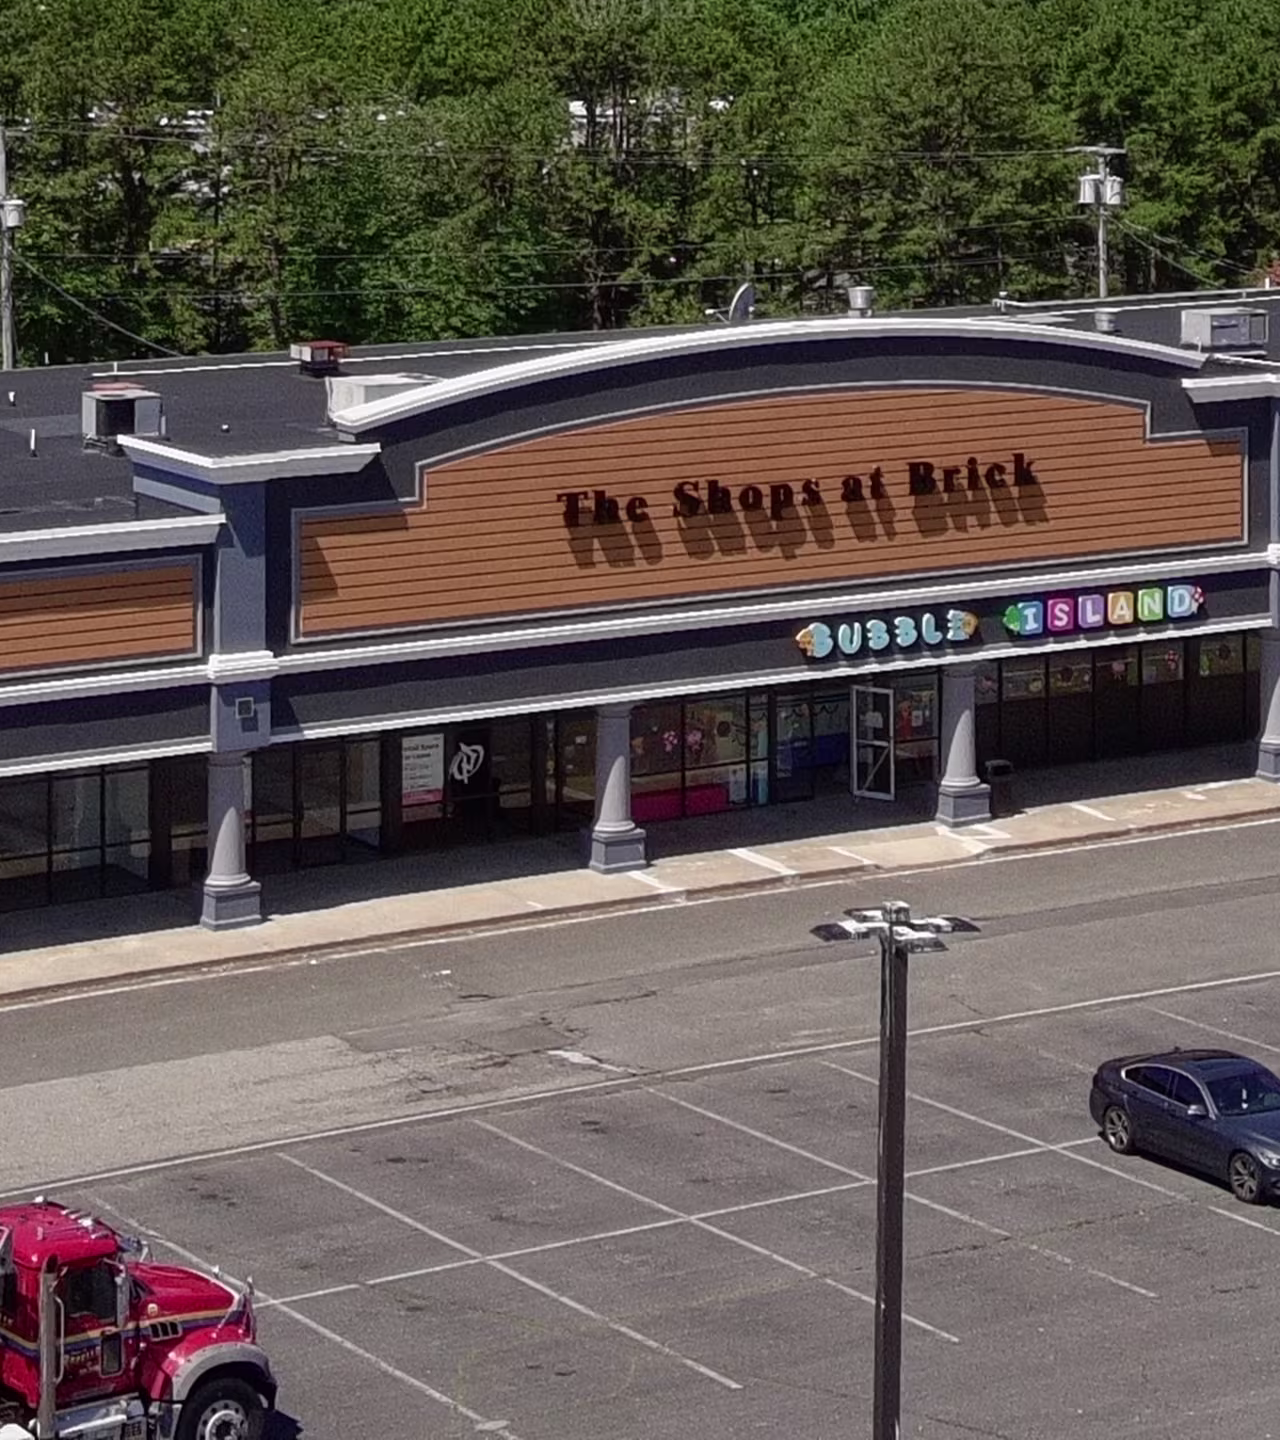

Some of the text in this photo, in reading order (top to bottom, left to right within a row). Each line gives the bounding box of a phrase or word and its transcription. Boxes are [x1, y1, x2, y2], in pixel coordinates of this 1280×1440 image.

[557, 453, 1036, 528] The Shops at Brick
[805, 586, 1195, 658] BUBBLE ISLAND
